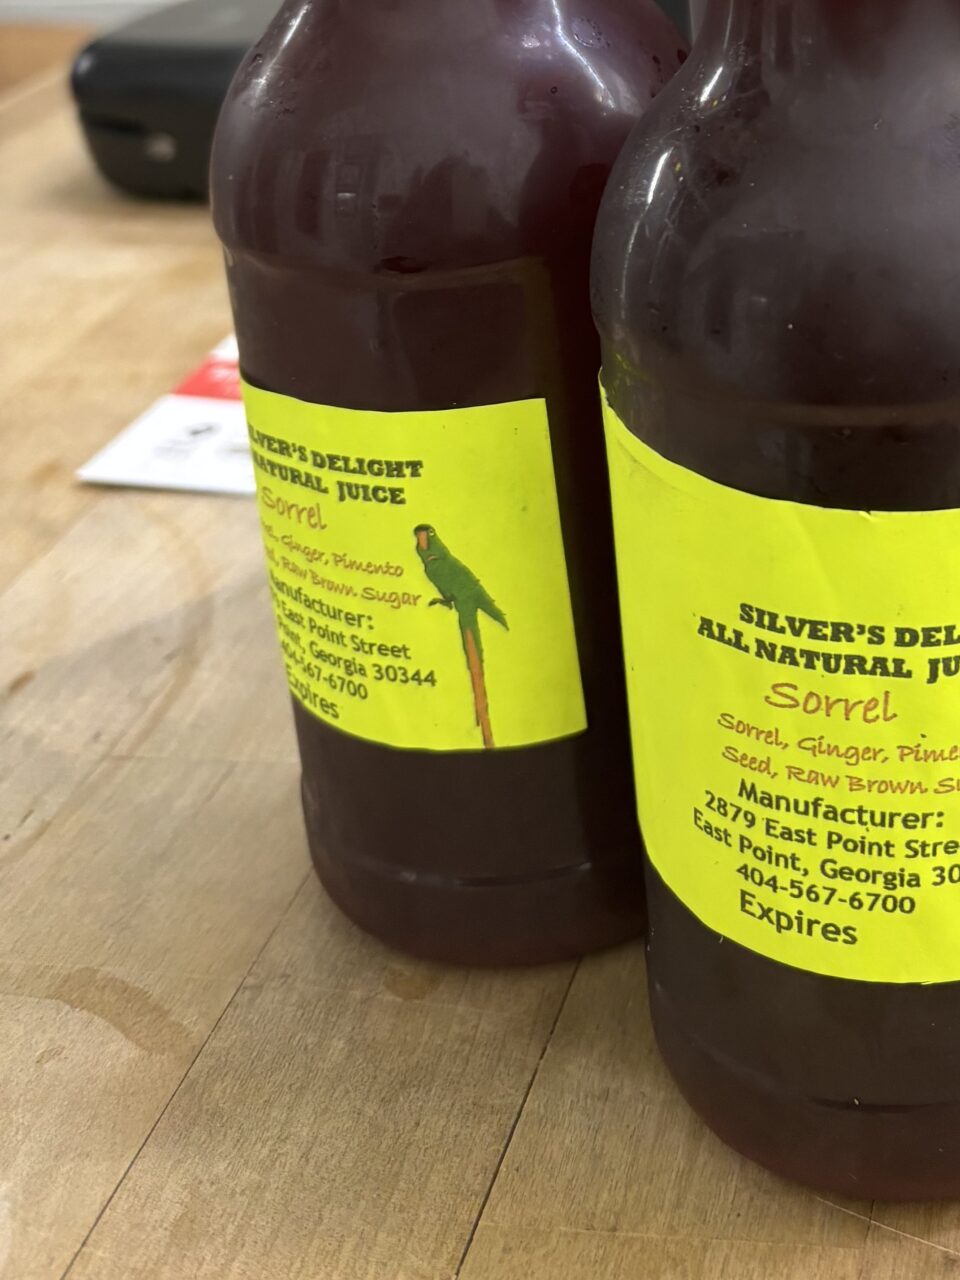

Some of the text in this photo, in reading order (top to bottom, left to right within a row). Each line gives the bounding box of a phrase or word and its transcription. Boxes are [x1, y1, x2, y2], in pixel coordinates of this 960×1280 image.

[310, 450, 424, 478] DELIGHT
[262, 486, 328, 530] Sorrel
[336, 481, 407, 505] JUICE
[331, 552, 404, 578] Pimento
[361, 587, 422, 609] Sugar
[308, 616, 348, 647] Point
[350, 634, 411, 660] Street
[697, 616, 750, 653] ALL
[755, 638, 912, 679] NATURAL
[739, 603, 885, 646] SILVER'S
[309, 640, 367, 678] Georgia
[371, 663, 437, 687] 30344
[765, 682, 898, 723] Sorrel
[717, 712, 788, 749] Sorrel,
[797, 735, 889, 765] Ginger,
[722, 745, 779, 777] Seed,
[787, 765, 839, 788] Raw
[846, 774, 928, 795] Brown
[704, 791, 756, 829] 2879
[764, 816, 817, 847] East
[827, 830, 895, 859] Point
[738, 779, 945, 829] Manufacturer:
[694, 807, 732, 848] East
[739, 836, 809, 877] Point,
[820, 861, 922, 892] Georgia
[736, 863, 915, 915] 404-567-6700
[740, 890, 858, 945] Expires
